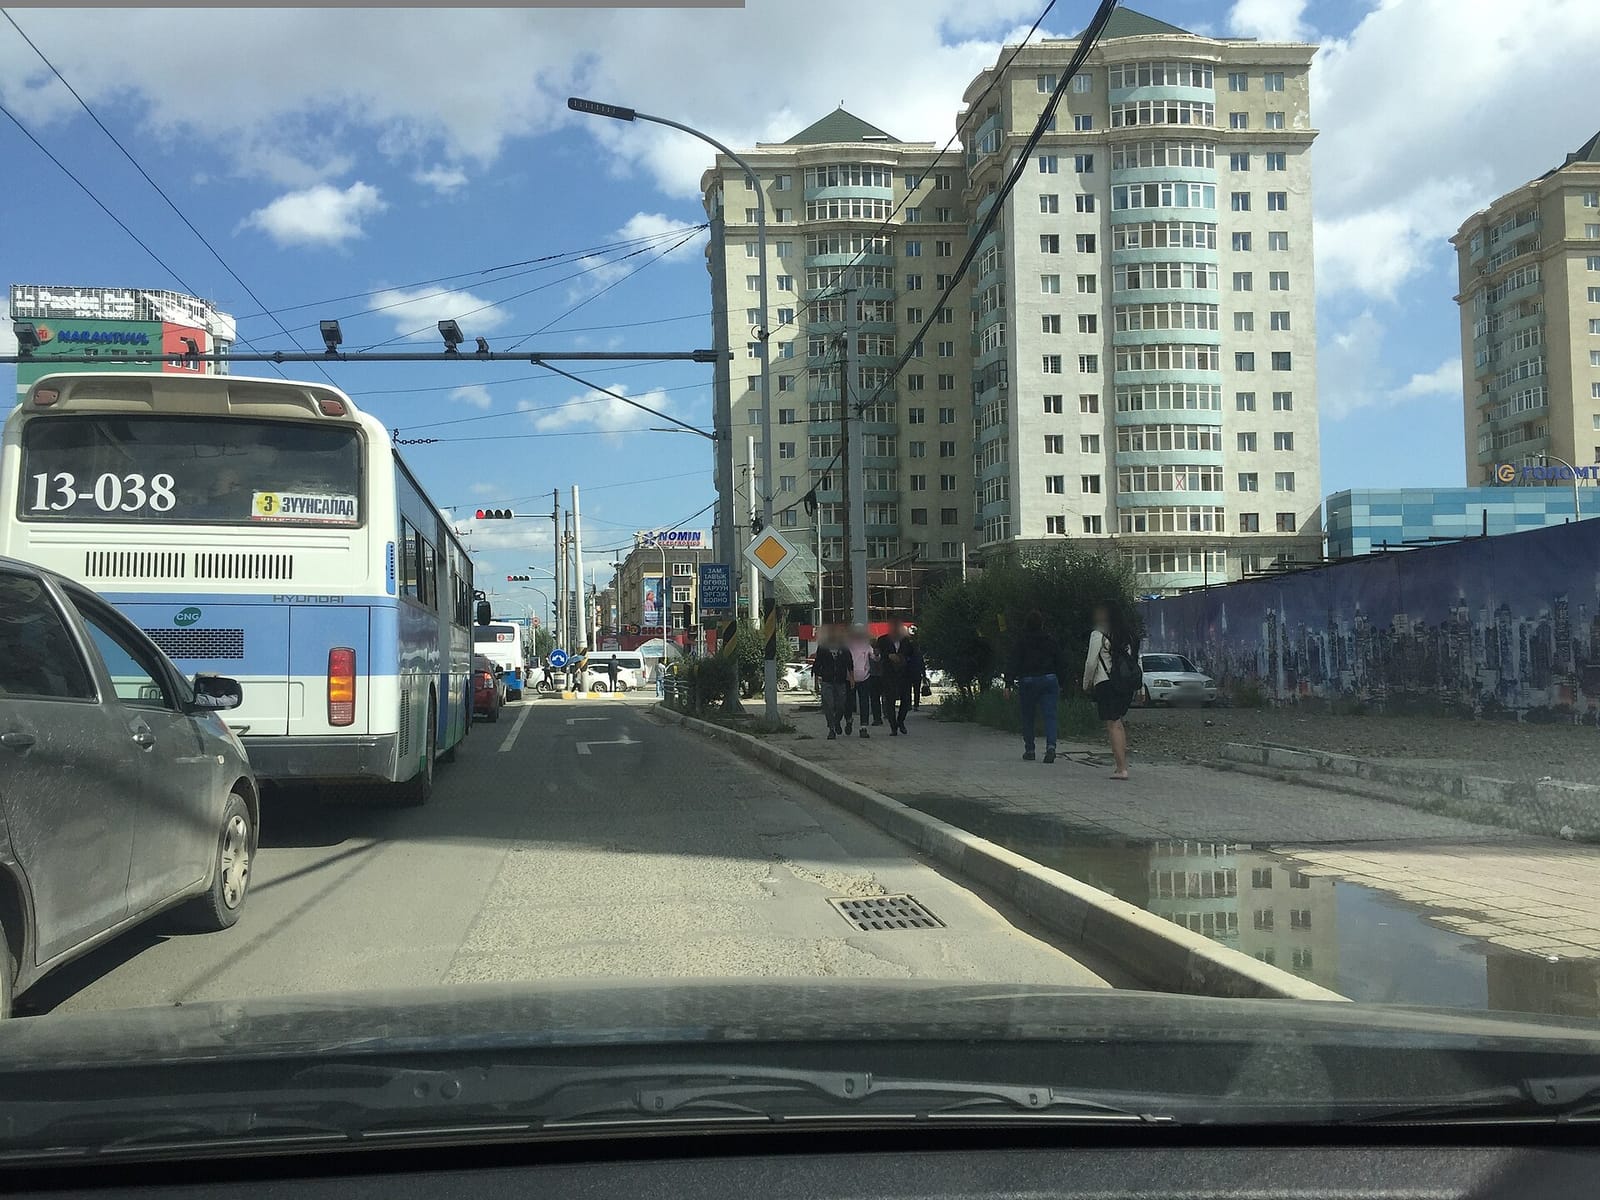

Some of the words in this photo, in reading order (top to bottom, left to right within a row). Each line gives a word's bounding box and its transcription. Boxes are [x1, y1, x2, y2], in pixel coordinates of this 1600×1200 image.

[31, 472, 177, 513] 13-038
[263, 495, 274, 512] 3
[658, 531, 702, 541] NOMIN
[273, 594, 344, 604] HYUNDAI
[176, 612, 200, 622] CNG
